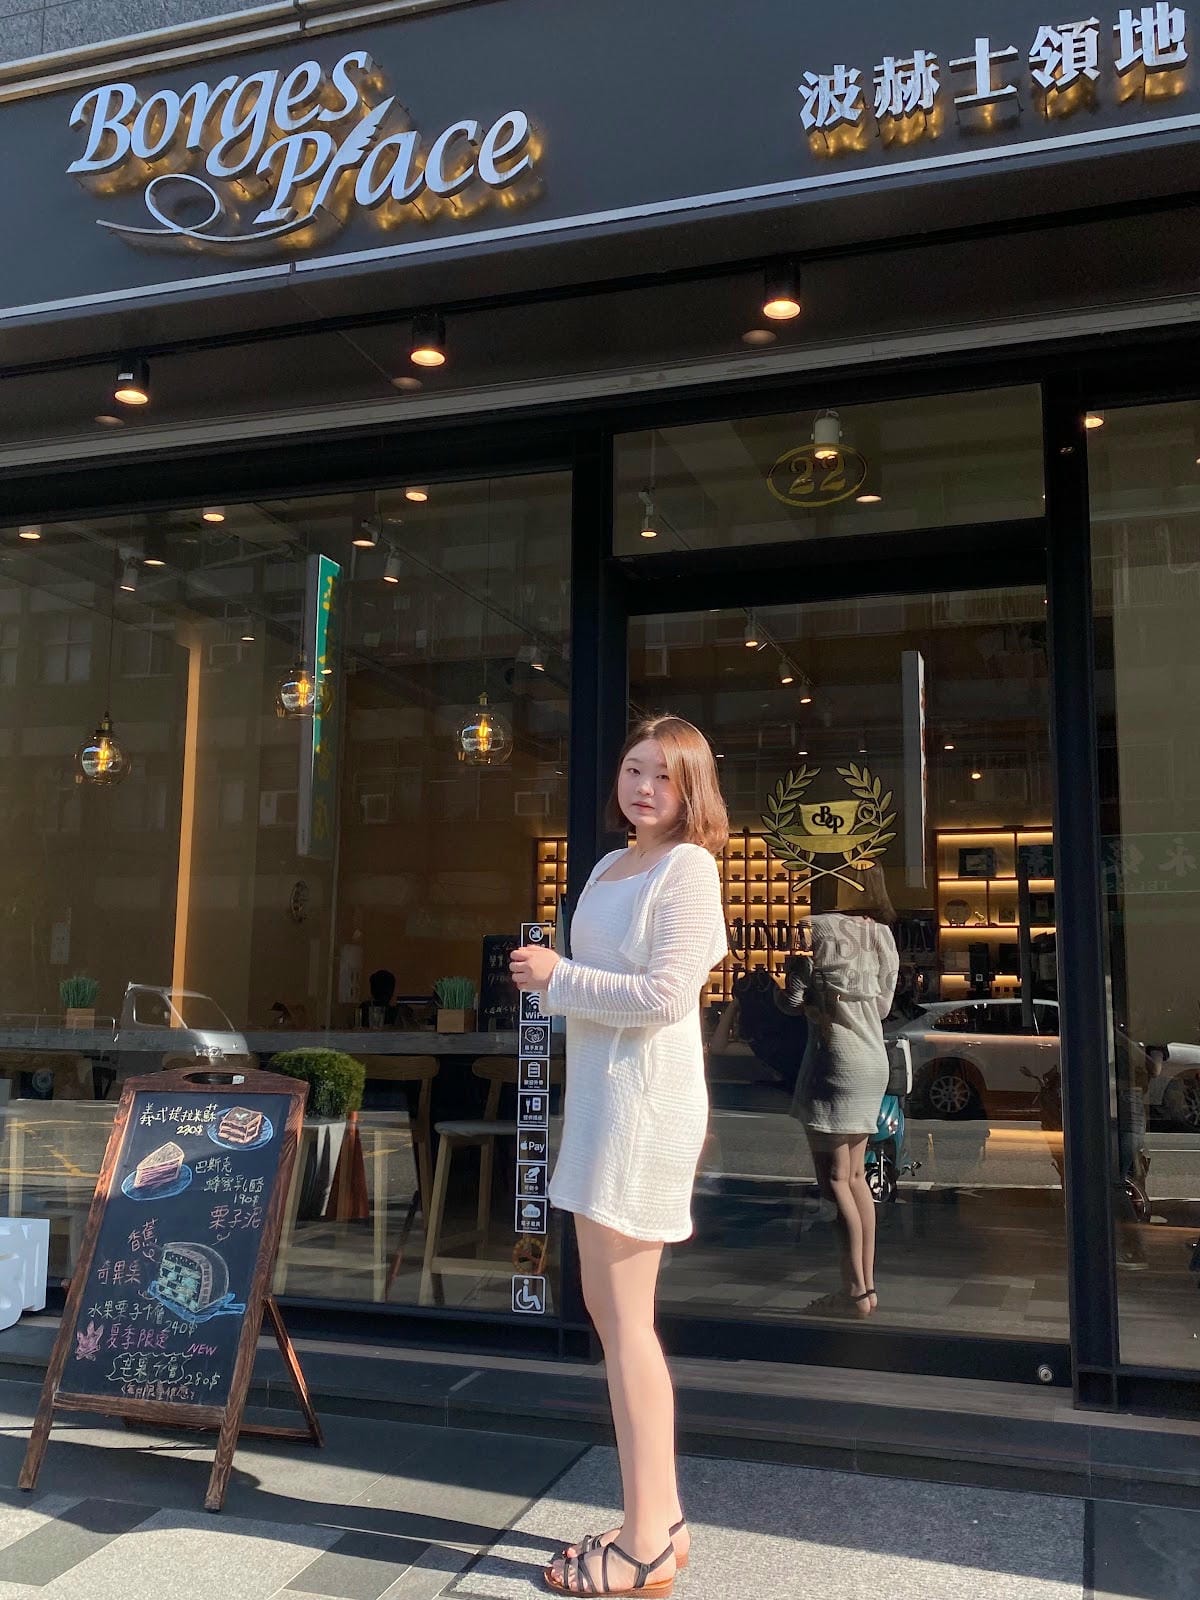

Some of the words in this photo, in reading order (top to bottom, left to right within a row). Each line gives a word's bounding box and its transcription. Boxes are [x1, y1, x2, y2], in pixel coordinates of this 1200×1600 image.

[797, 1, 1189, 131] 波赫士領地
[65, 50, 376, 181] Borges
[252, 96, 535, 230] Place
[788, 449, 846, 495] 22
[525, 1011, 546, 1020] WiF
[528, 1141, 545, 1153] Pay
[186, 1343, 218, 1356] NEW
